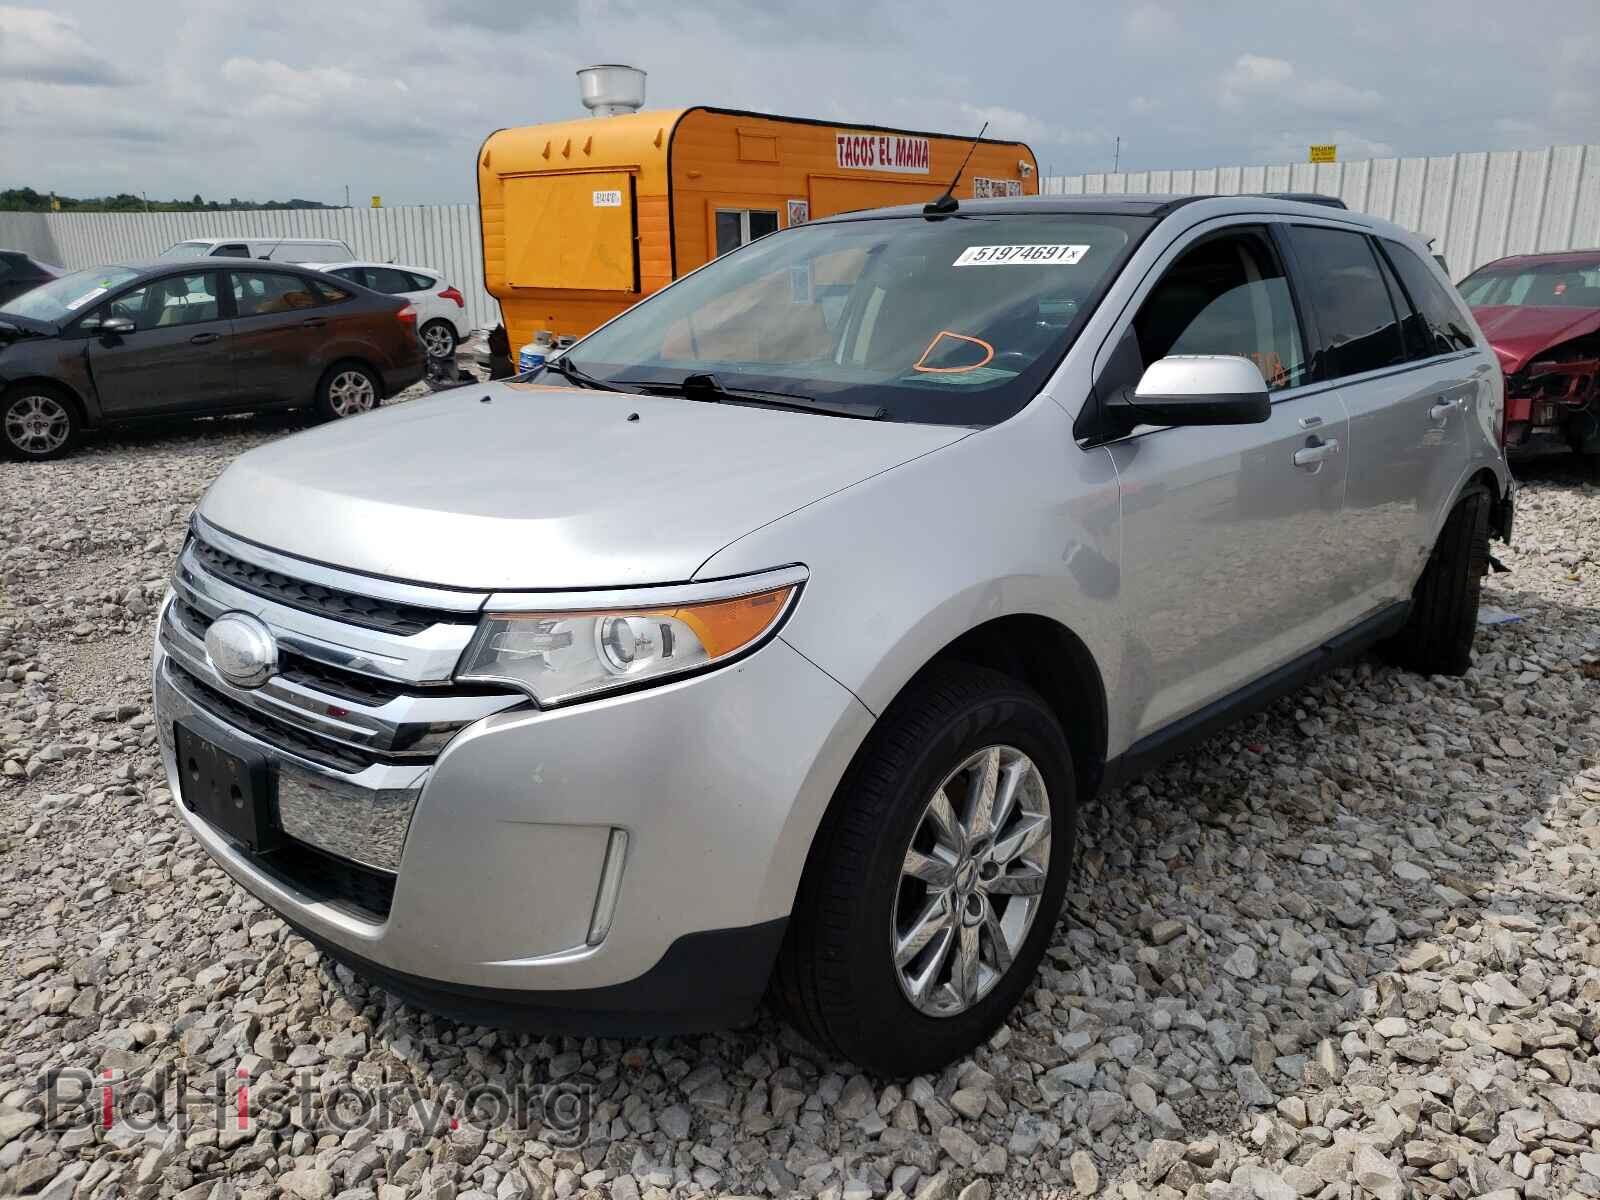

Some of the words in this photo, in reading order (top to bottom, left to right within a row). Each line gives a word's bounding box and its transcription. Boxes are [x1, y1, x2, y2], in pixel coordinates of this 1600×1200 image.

[837, 136, 875, 167] TACOS
[879, 137, 892, 166] EL
[895, 138, 929, 168] MANA
